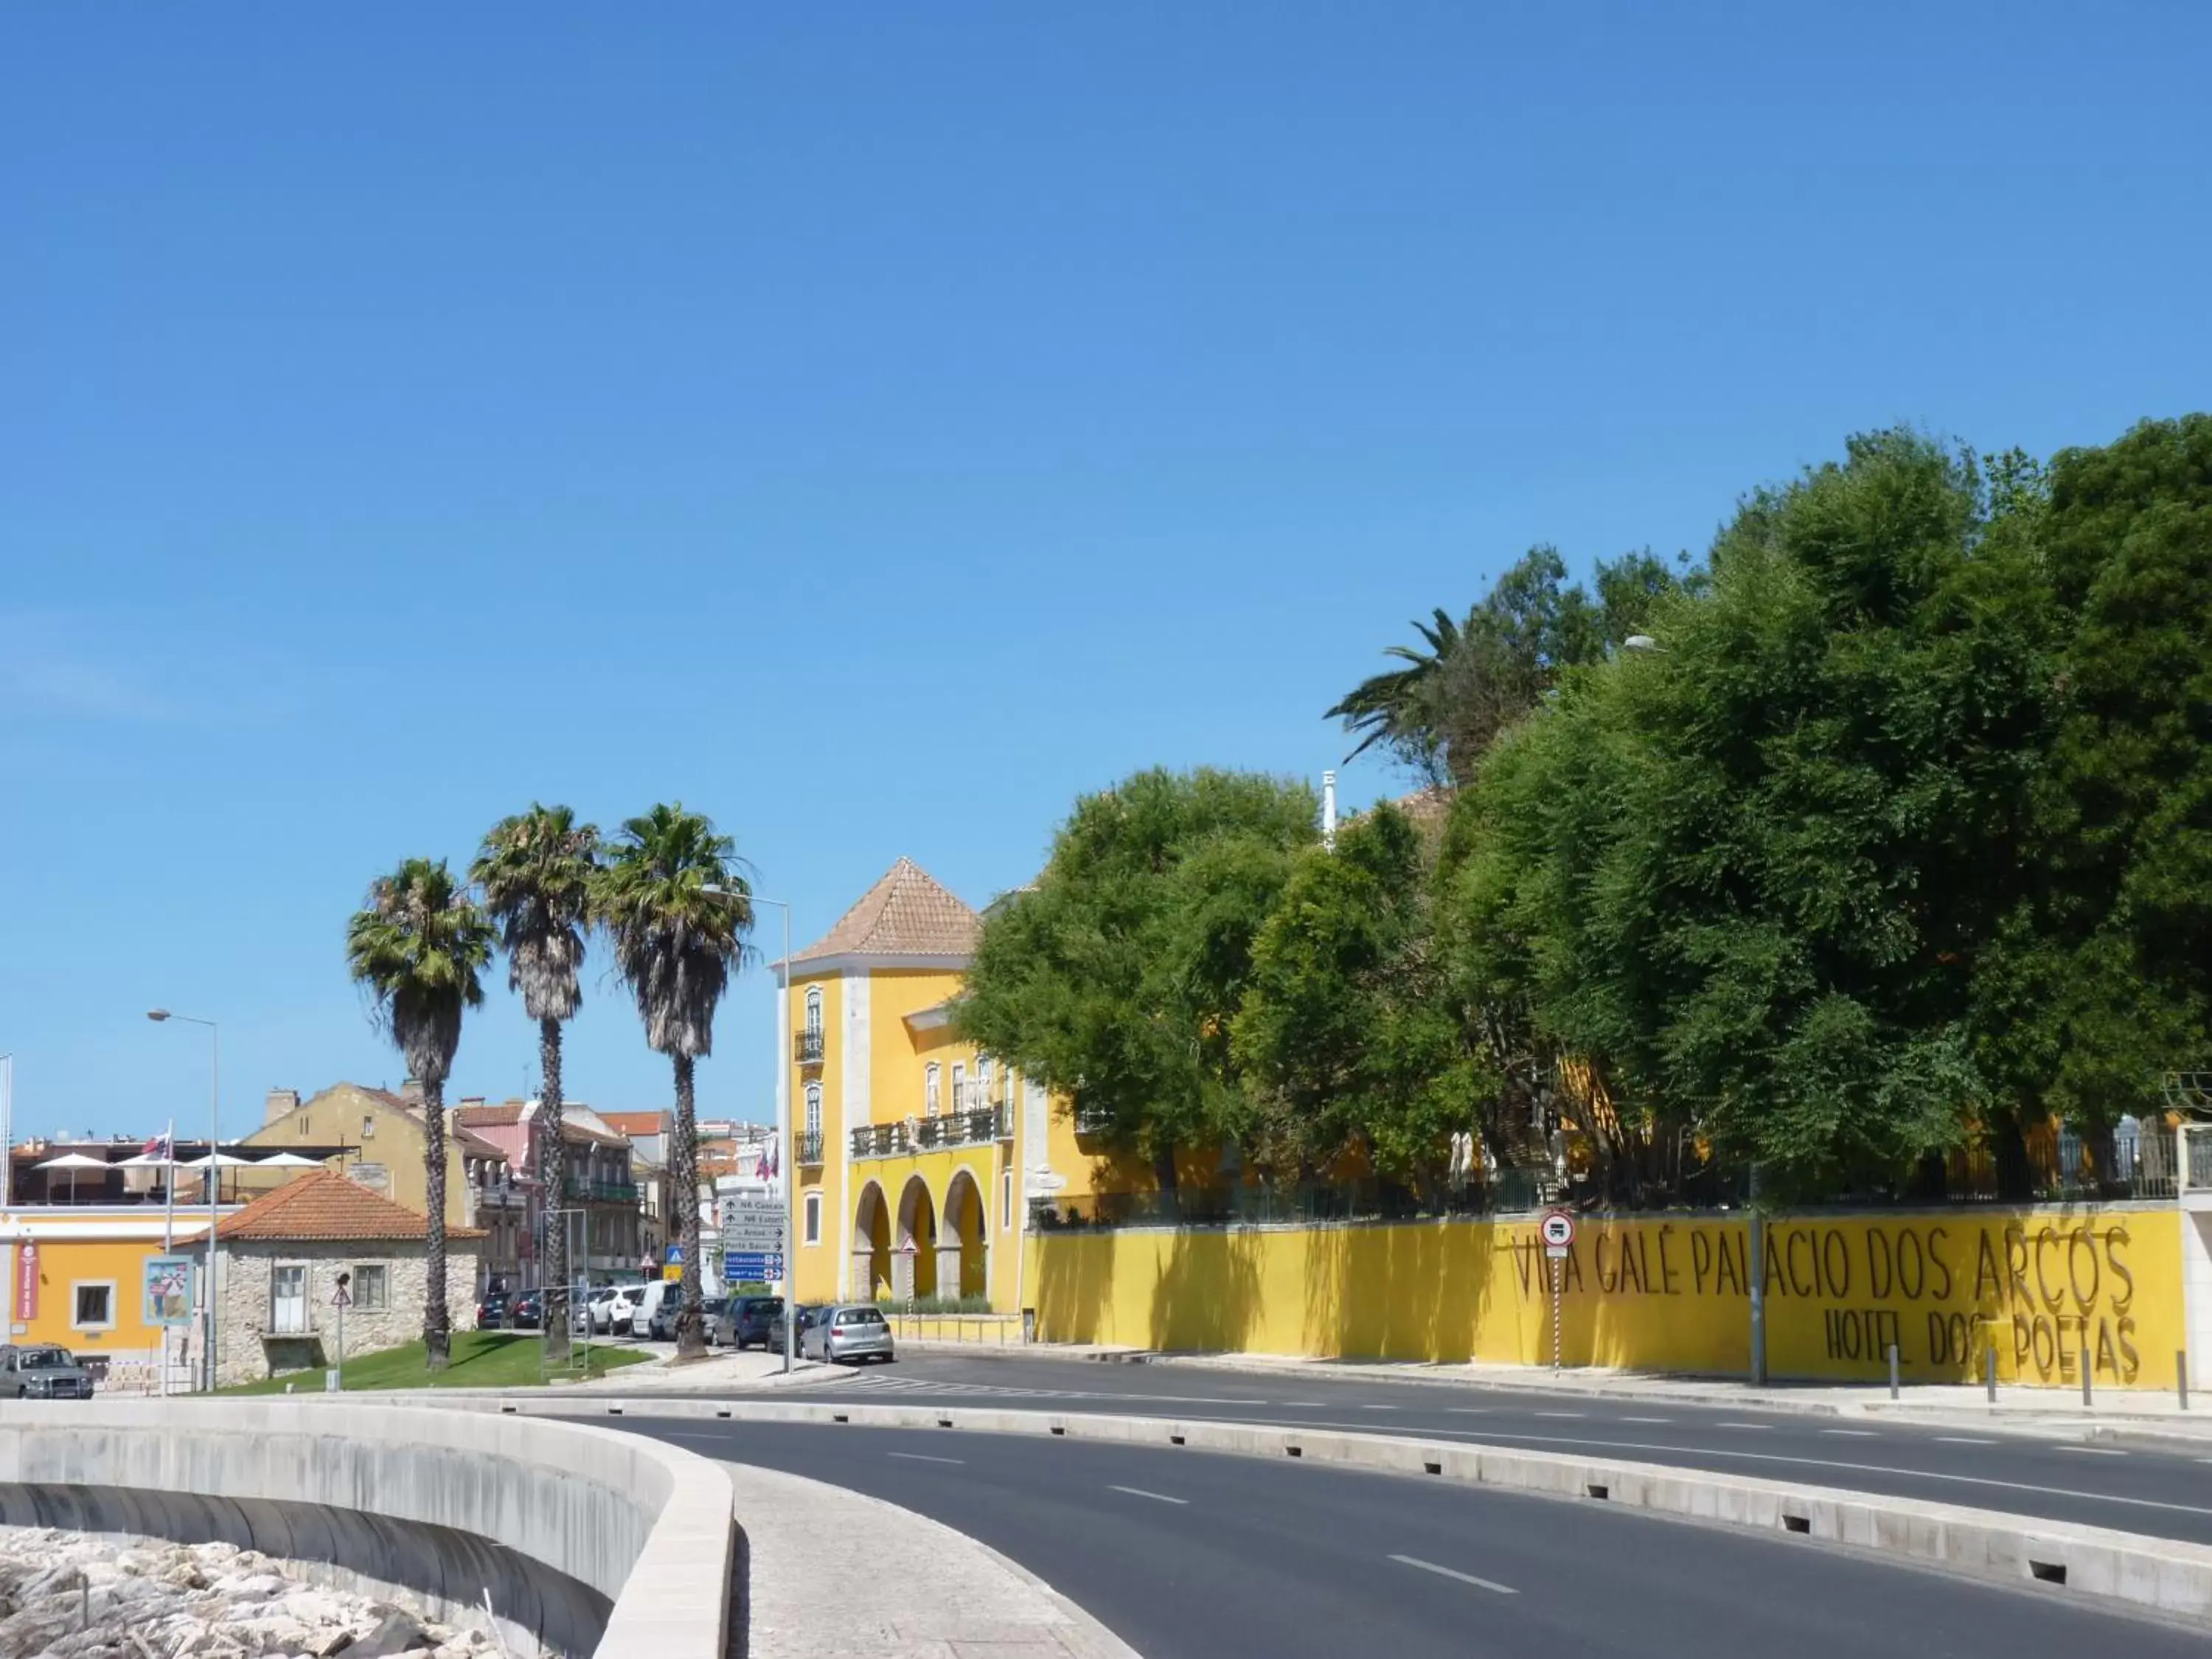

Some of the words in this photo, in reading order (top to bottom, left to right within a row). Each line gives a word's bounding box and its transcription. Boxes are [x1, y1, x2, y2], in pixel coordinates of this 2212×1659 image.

[1596, 1224, 1682, 1294] GALÉ
[1691, 1222, 1848, 1298] PALÁCIO
[1866, 1227, 1952, 1300] DOS
[1975, 1226, 2134, 1309] ARCOS
[1825, 1309, 1912, 1364] HOTEL
[2013, 1315, 2140, 1374] POETAS
